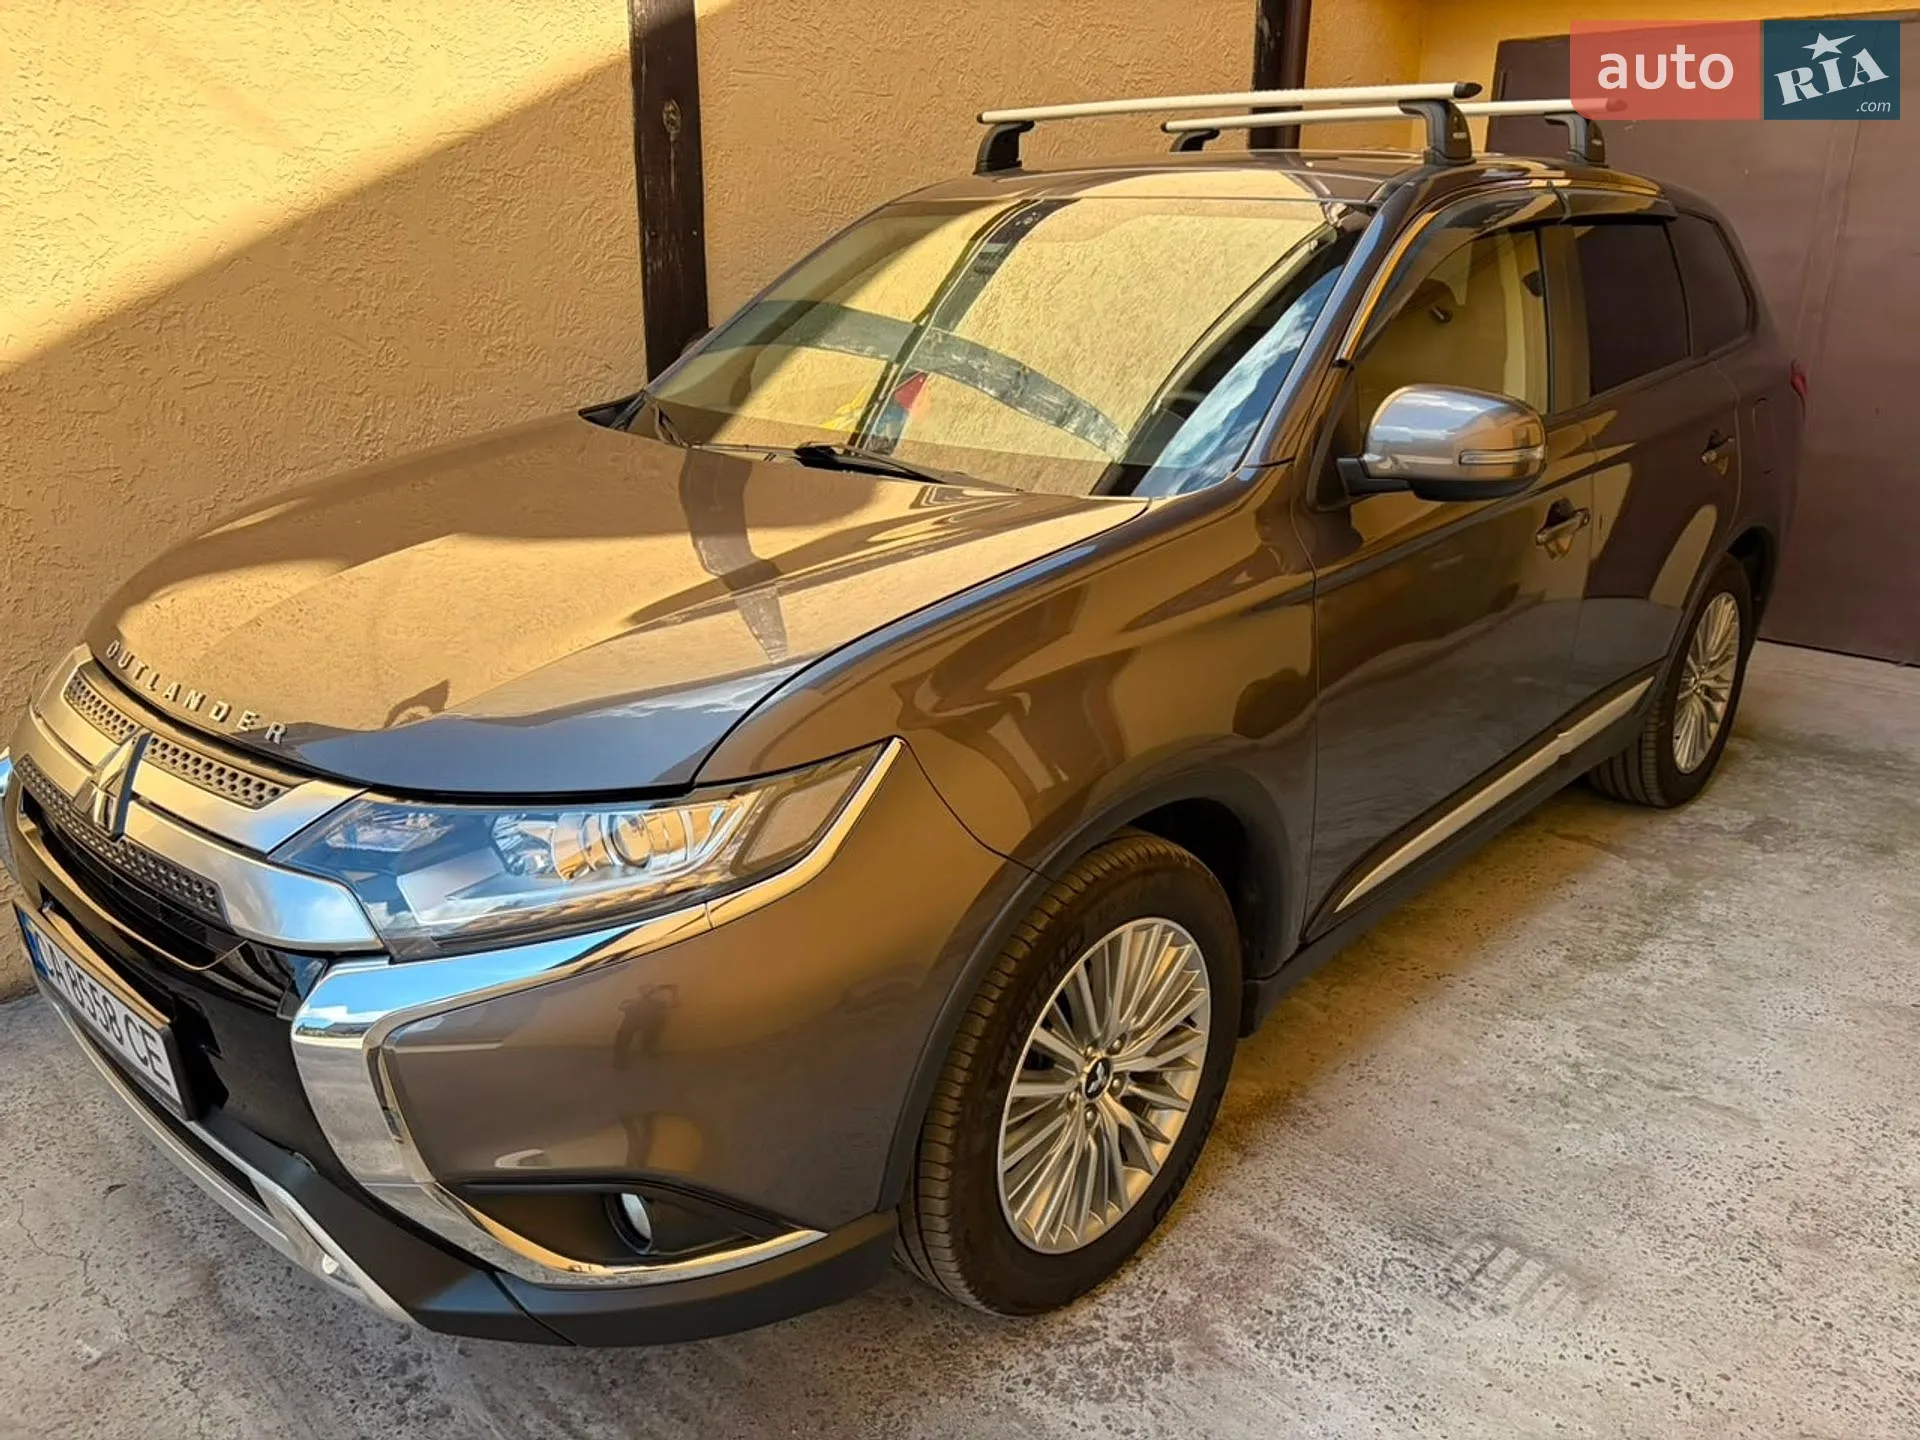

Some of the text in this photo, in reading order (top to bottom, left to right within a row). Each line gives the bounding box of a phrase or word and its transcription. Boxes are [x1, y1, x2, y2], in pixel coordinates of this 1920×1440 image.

[106, 640, 287, 744] OUTLANDER
[35, 933, 171, 1087] CA 8558 CE
